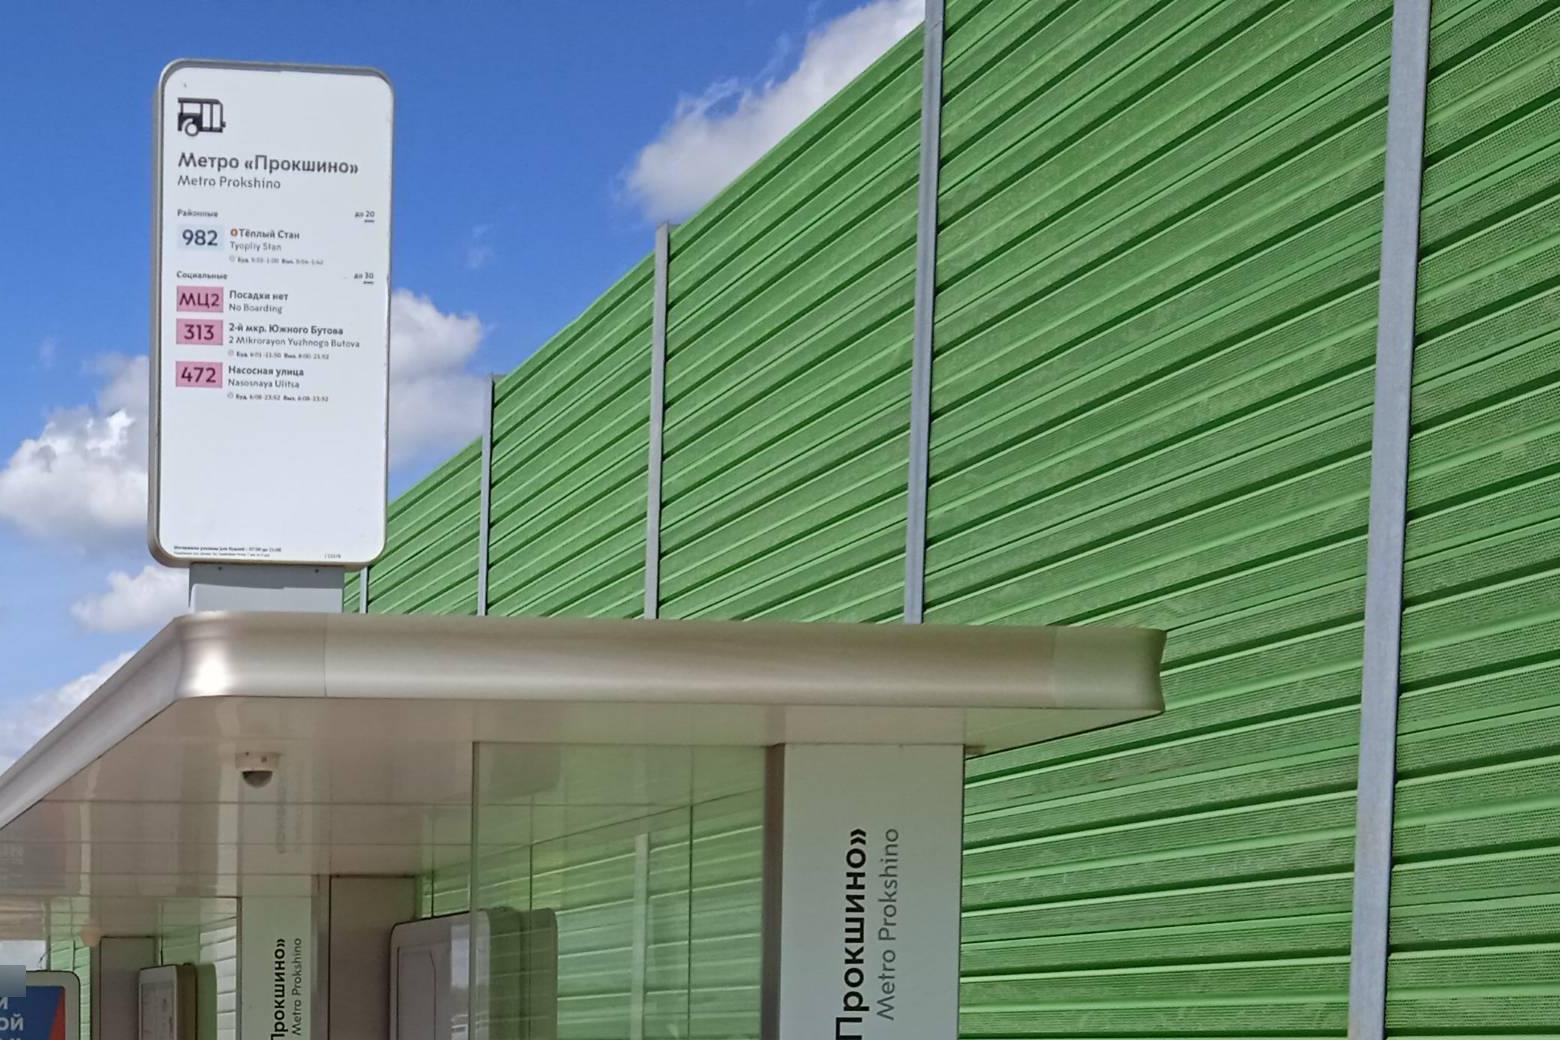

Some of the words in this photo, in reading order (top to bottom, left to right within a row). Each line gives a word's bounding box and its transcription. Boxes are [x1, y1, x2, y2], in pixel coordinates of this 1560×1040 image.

[178, 152, 239, 172] Метро
[244, 154, 359, 174] «Прокшино»
[177, 175, 216, 187] Metro
[219, 176, 281, 189] Prokshino
[182, 229, 218, 246] 982
[239, 228, 276, 240] Тёплый
[277, 230, 300, 240] Стан
[265, 242, 282, 251] Stan
[176, 271, 228, 281] Социальные
[179, 292, 220, 308] МЦ2
[229, 290, 271, 301] Посадки
[272, 292, 289, 301] нет
[229, 303, 242, 312] No
[243, 304, 283, 315] Boarding
[184, 324, 214, 341] 313
[228, 323, 244, 333] 2-й
[245, 325, 267, 336] мкр.
[269, 325, 309, 336] Южного
[310, 326, 344, 336] Бутова
[228, 336, 235, 345] 2
[235, 336, 286, 348] Mikrorayon
[287, 338, 329, 349] Yuzhnogo
[331, 339, 360, 348] Butova
[181, 367, 216, 384] 472
[228, 366, 274, 376] Насосная
[276, 368, 304, 378] улица
[228, 378, 273, 390] Nasosnaya
[275, 380, 300, 389] Ulitsa
[878, 828, 899, 941] Prokshino
[292, 938, 302, 996] Prokshino
[877, 949, 896, 1021] Metro
[292, 1001, 302, 1036] Metro
